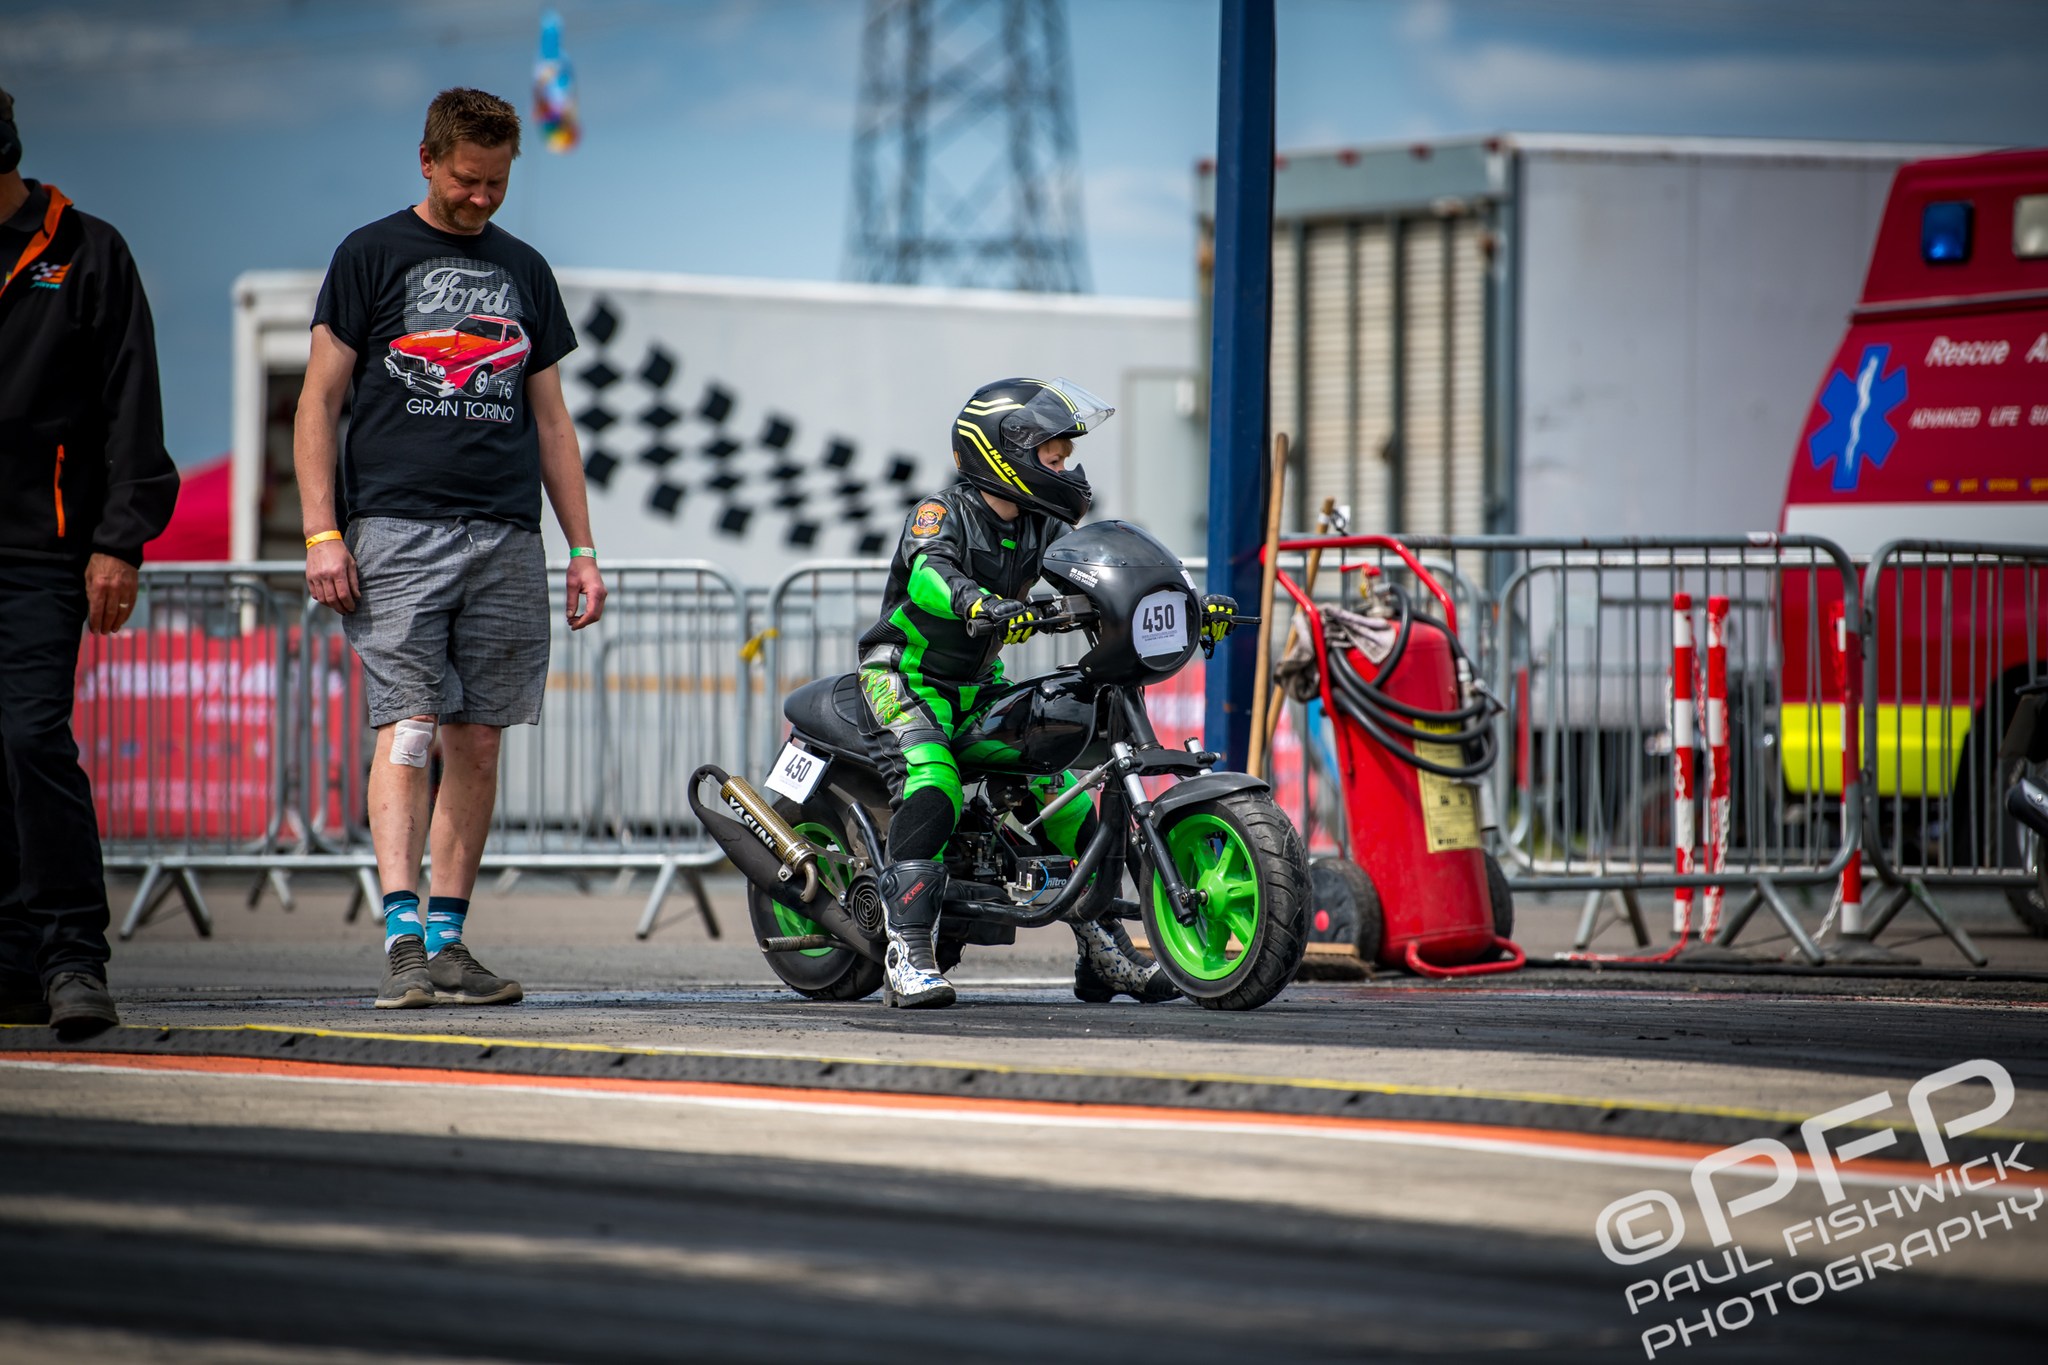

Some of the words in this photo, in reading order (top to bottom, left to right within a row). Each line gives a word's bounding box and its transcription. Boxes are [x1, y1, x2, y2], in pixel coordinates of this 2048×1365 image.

[417, 267, 510, 315] Ford
[1924, 335, 2010, 367] Rescue
[406, 398, 458, 416] GRAN
[463, 401, 515, 421] TORINO
[1908, 407, 1982, 429] ADVANCED
[1988, 405, 2021, 427] LIFE
[989, 449, 1017, 477] HJC
[1142, 603, 1175, 633] 450
[784, 753, 813, 783] 450
